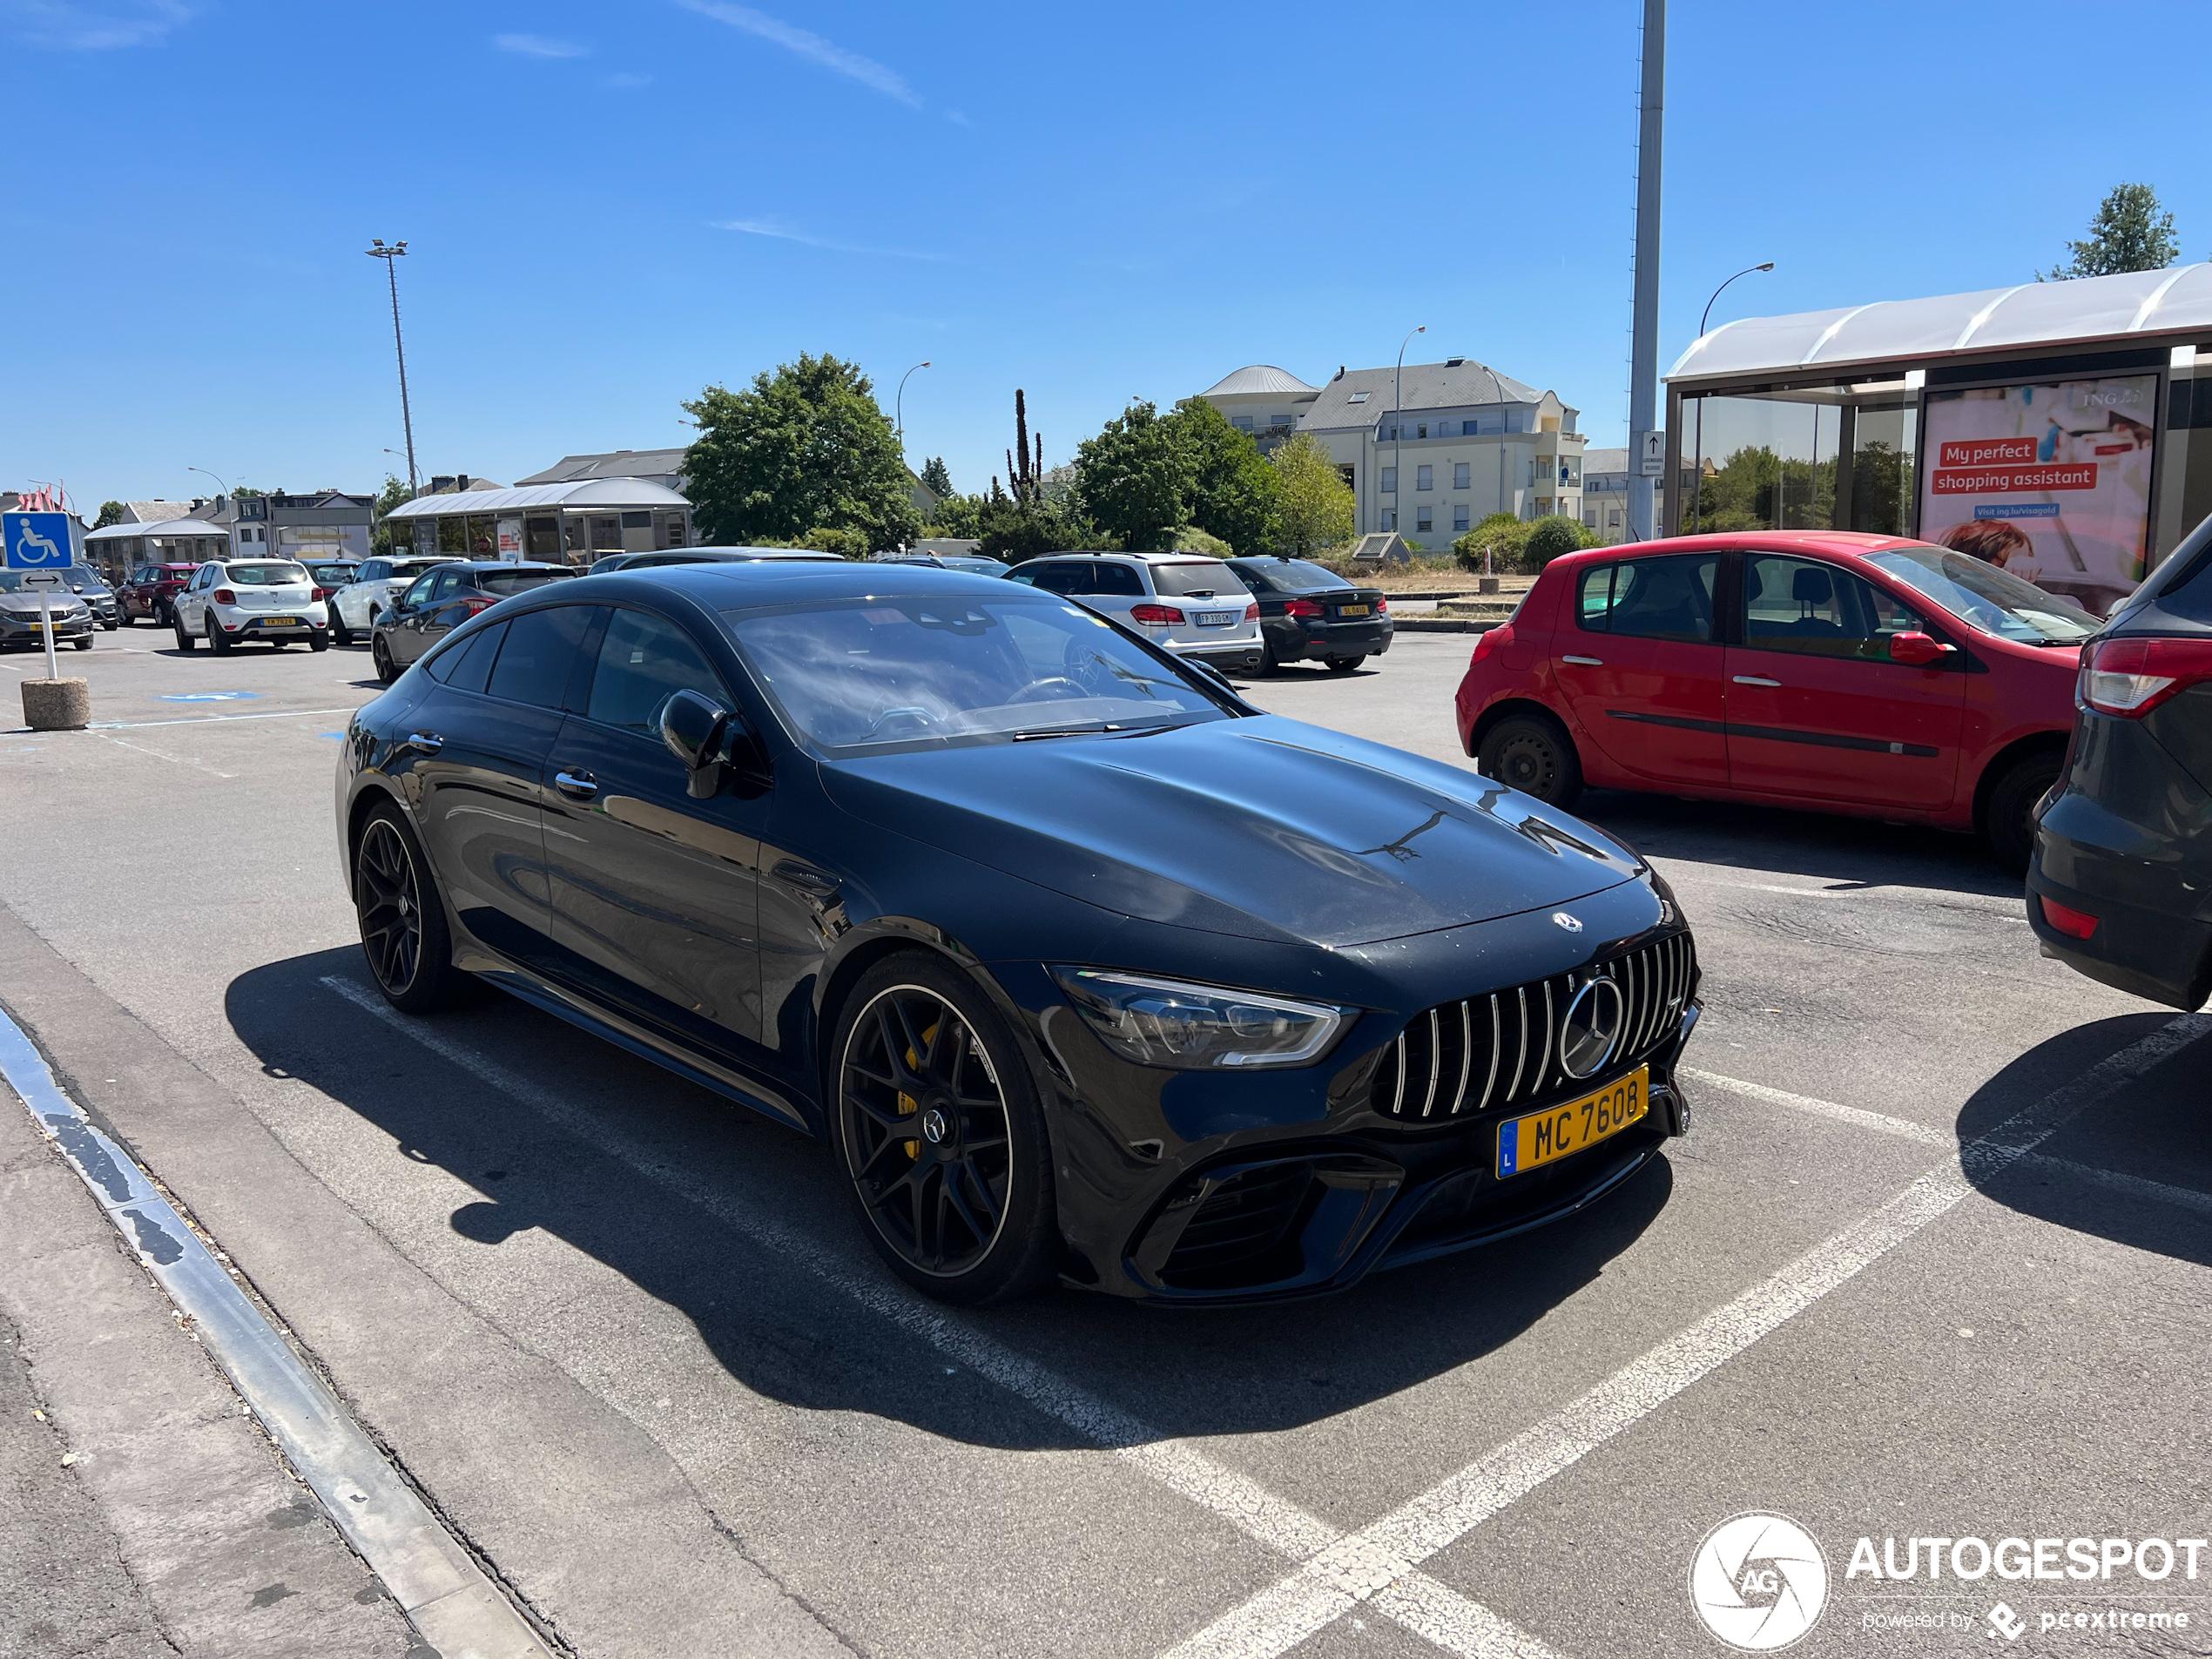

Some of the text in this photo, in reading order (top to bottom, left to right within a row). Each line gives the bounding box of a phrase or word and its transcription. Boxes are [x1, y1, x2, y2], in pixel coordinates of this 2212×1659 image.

[2082, 393, 2117, 407] ING
[1946, 443, 2031, 464] My perfect
[1938, 469, 2091, 492] shopping assistant
[1996, 506, 2057, 516] ing.lu/visagold
[1202, 615, 1209, 624] FP
[1211, 614, 1221, 623] 330
[1534, 1081, 1637, 1160] MC 7608
[1504, 1154, 1511, 1168] L
